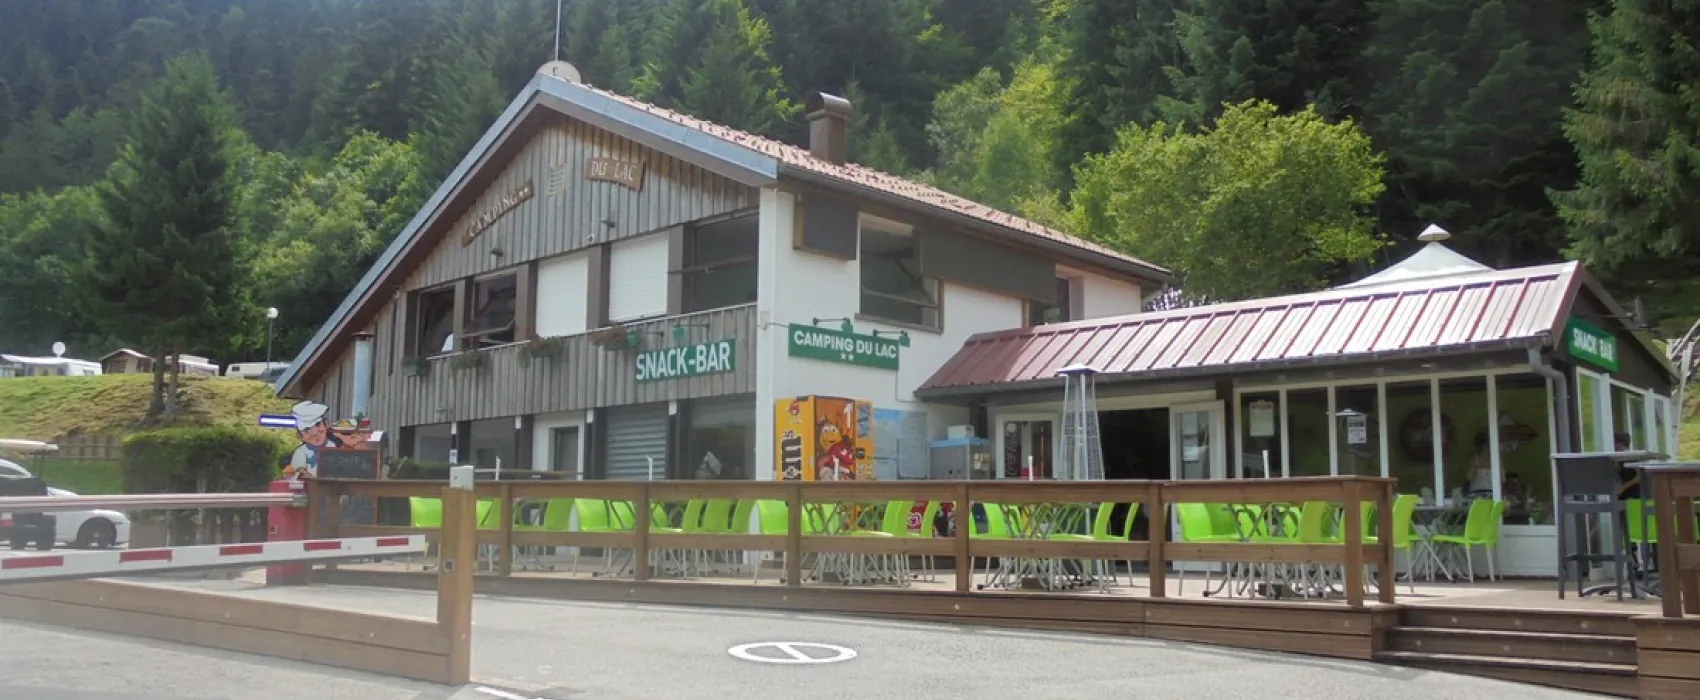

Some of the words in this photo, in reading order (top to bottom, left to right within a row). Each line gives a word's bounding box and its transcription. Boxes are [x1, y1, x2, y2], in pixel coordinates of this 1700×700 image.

[591, 161, 608, 176] DU
[614, 162, 638, 181] LAC
[469, 193, 518, 237] CAMPING
[793, 330, 854, 352] CAMPING
[856, 340, 872, 355] DU
[875, 342, 897, 358] LAC
[1573, 328, 1597, 356] SNACK
[636, 341, 731, 380] SNACK-BAR
